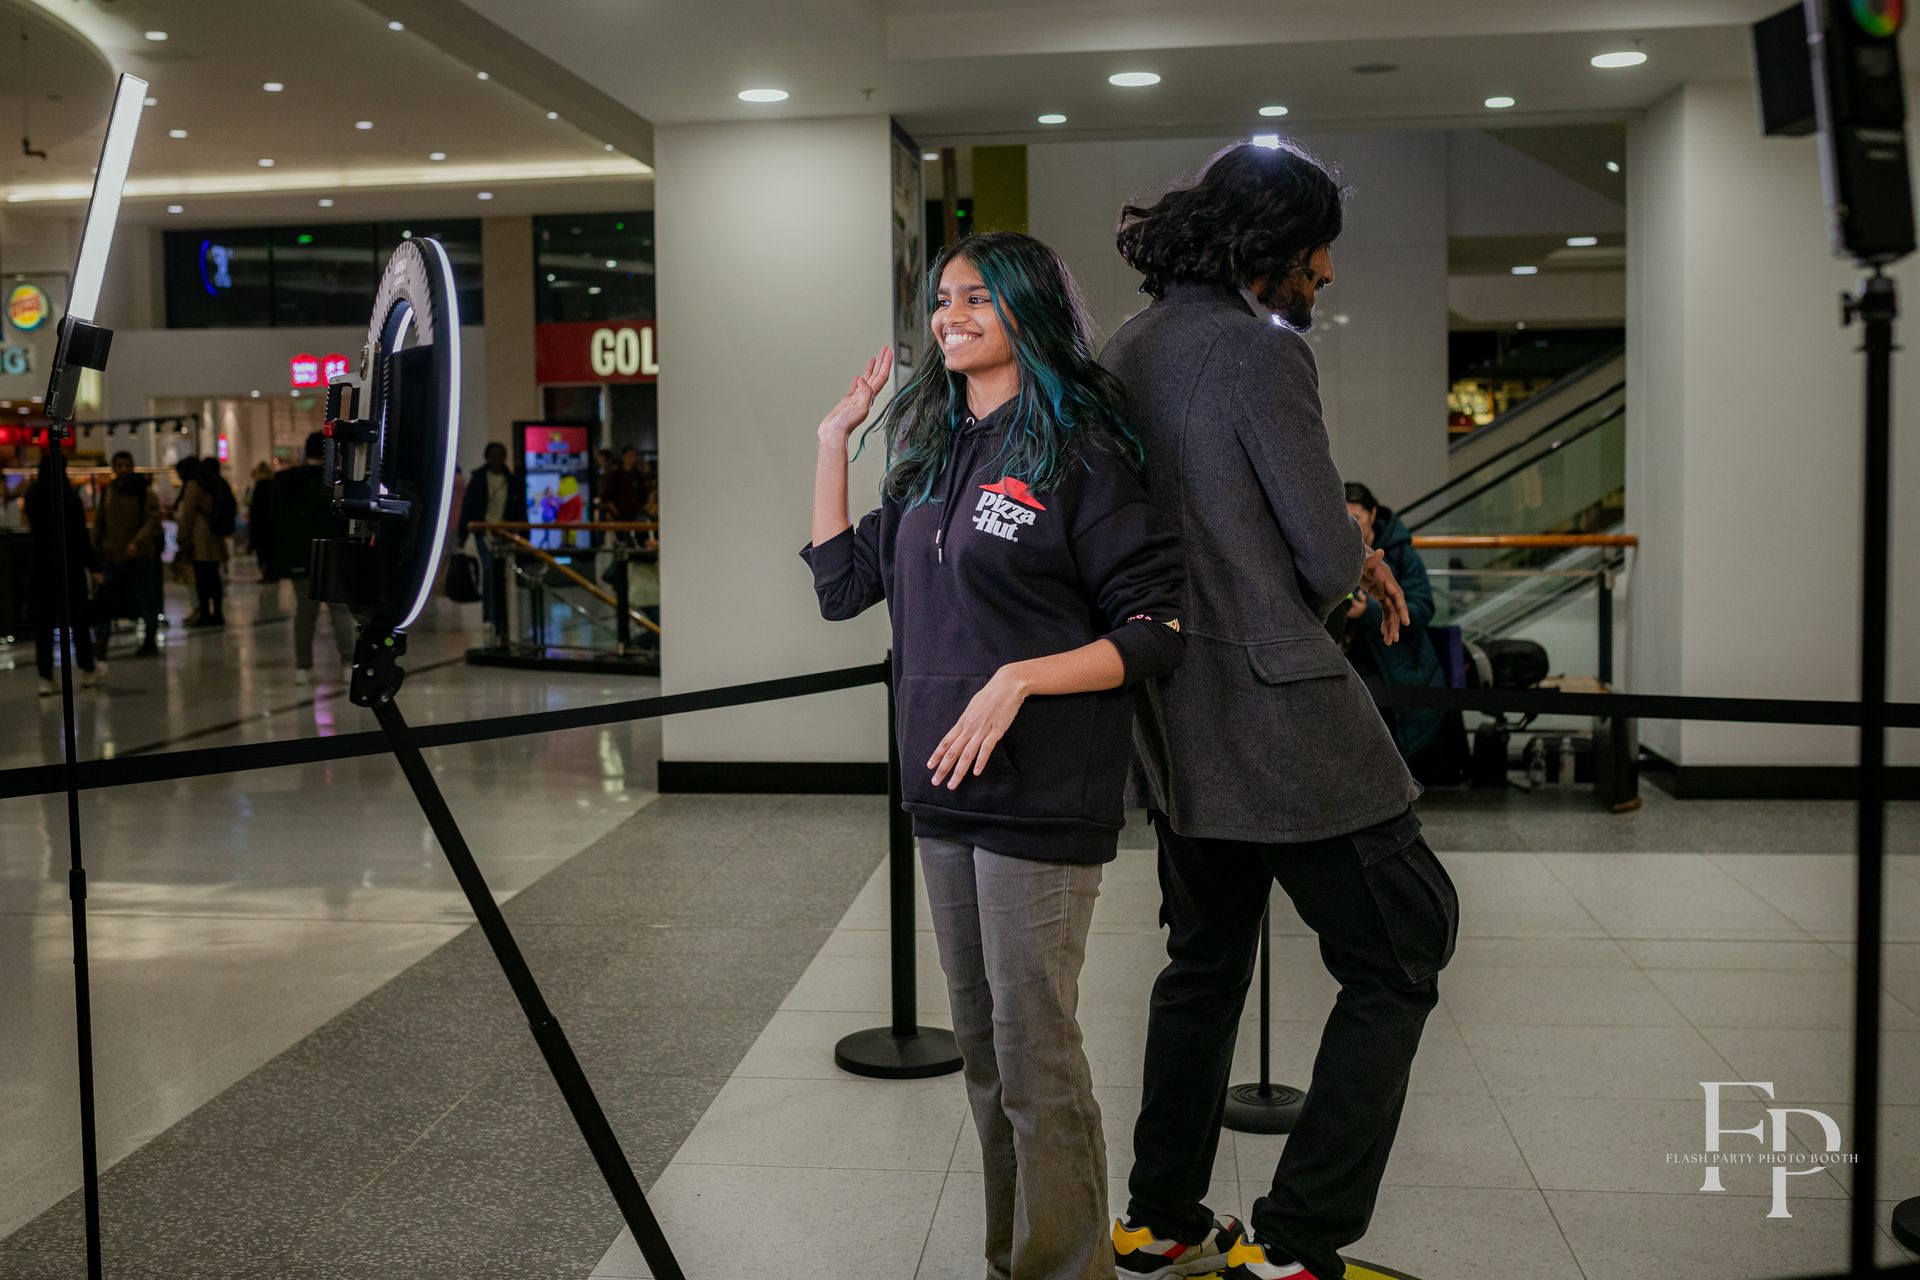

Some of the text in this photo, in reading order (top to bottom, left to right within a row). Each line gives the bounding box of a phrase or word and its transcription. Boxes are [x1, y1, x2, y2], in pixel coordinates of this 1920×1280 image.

[0, 346, 28, 376] G
[591, 327, 659, 376] GOL
[975, 491, 1036, 525] Pizza
